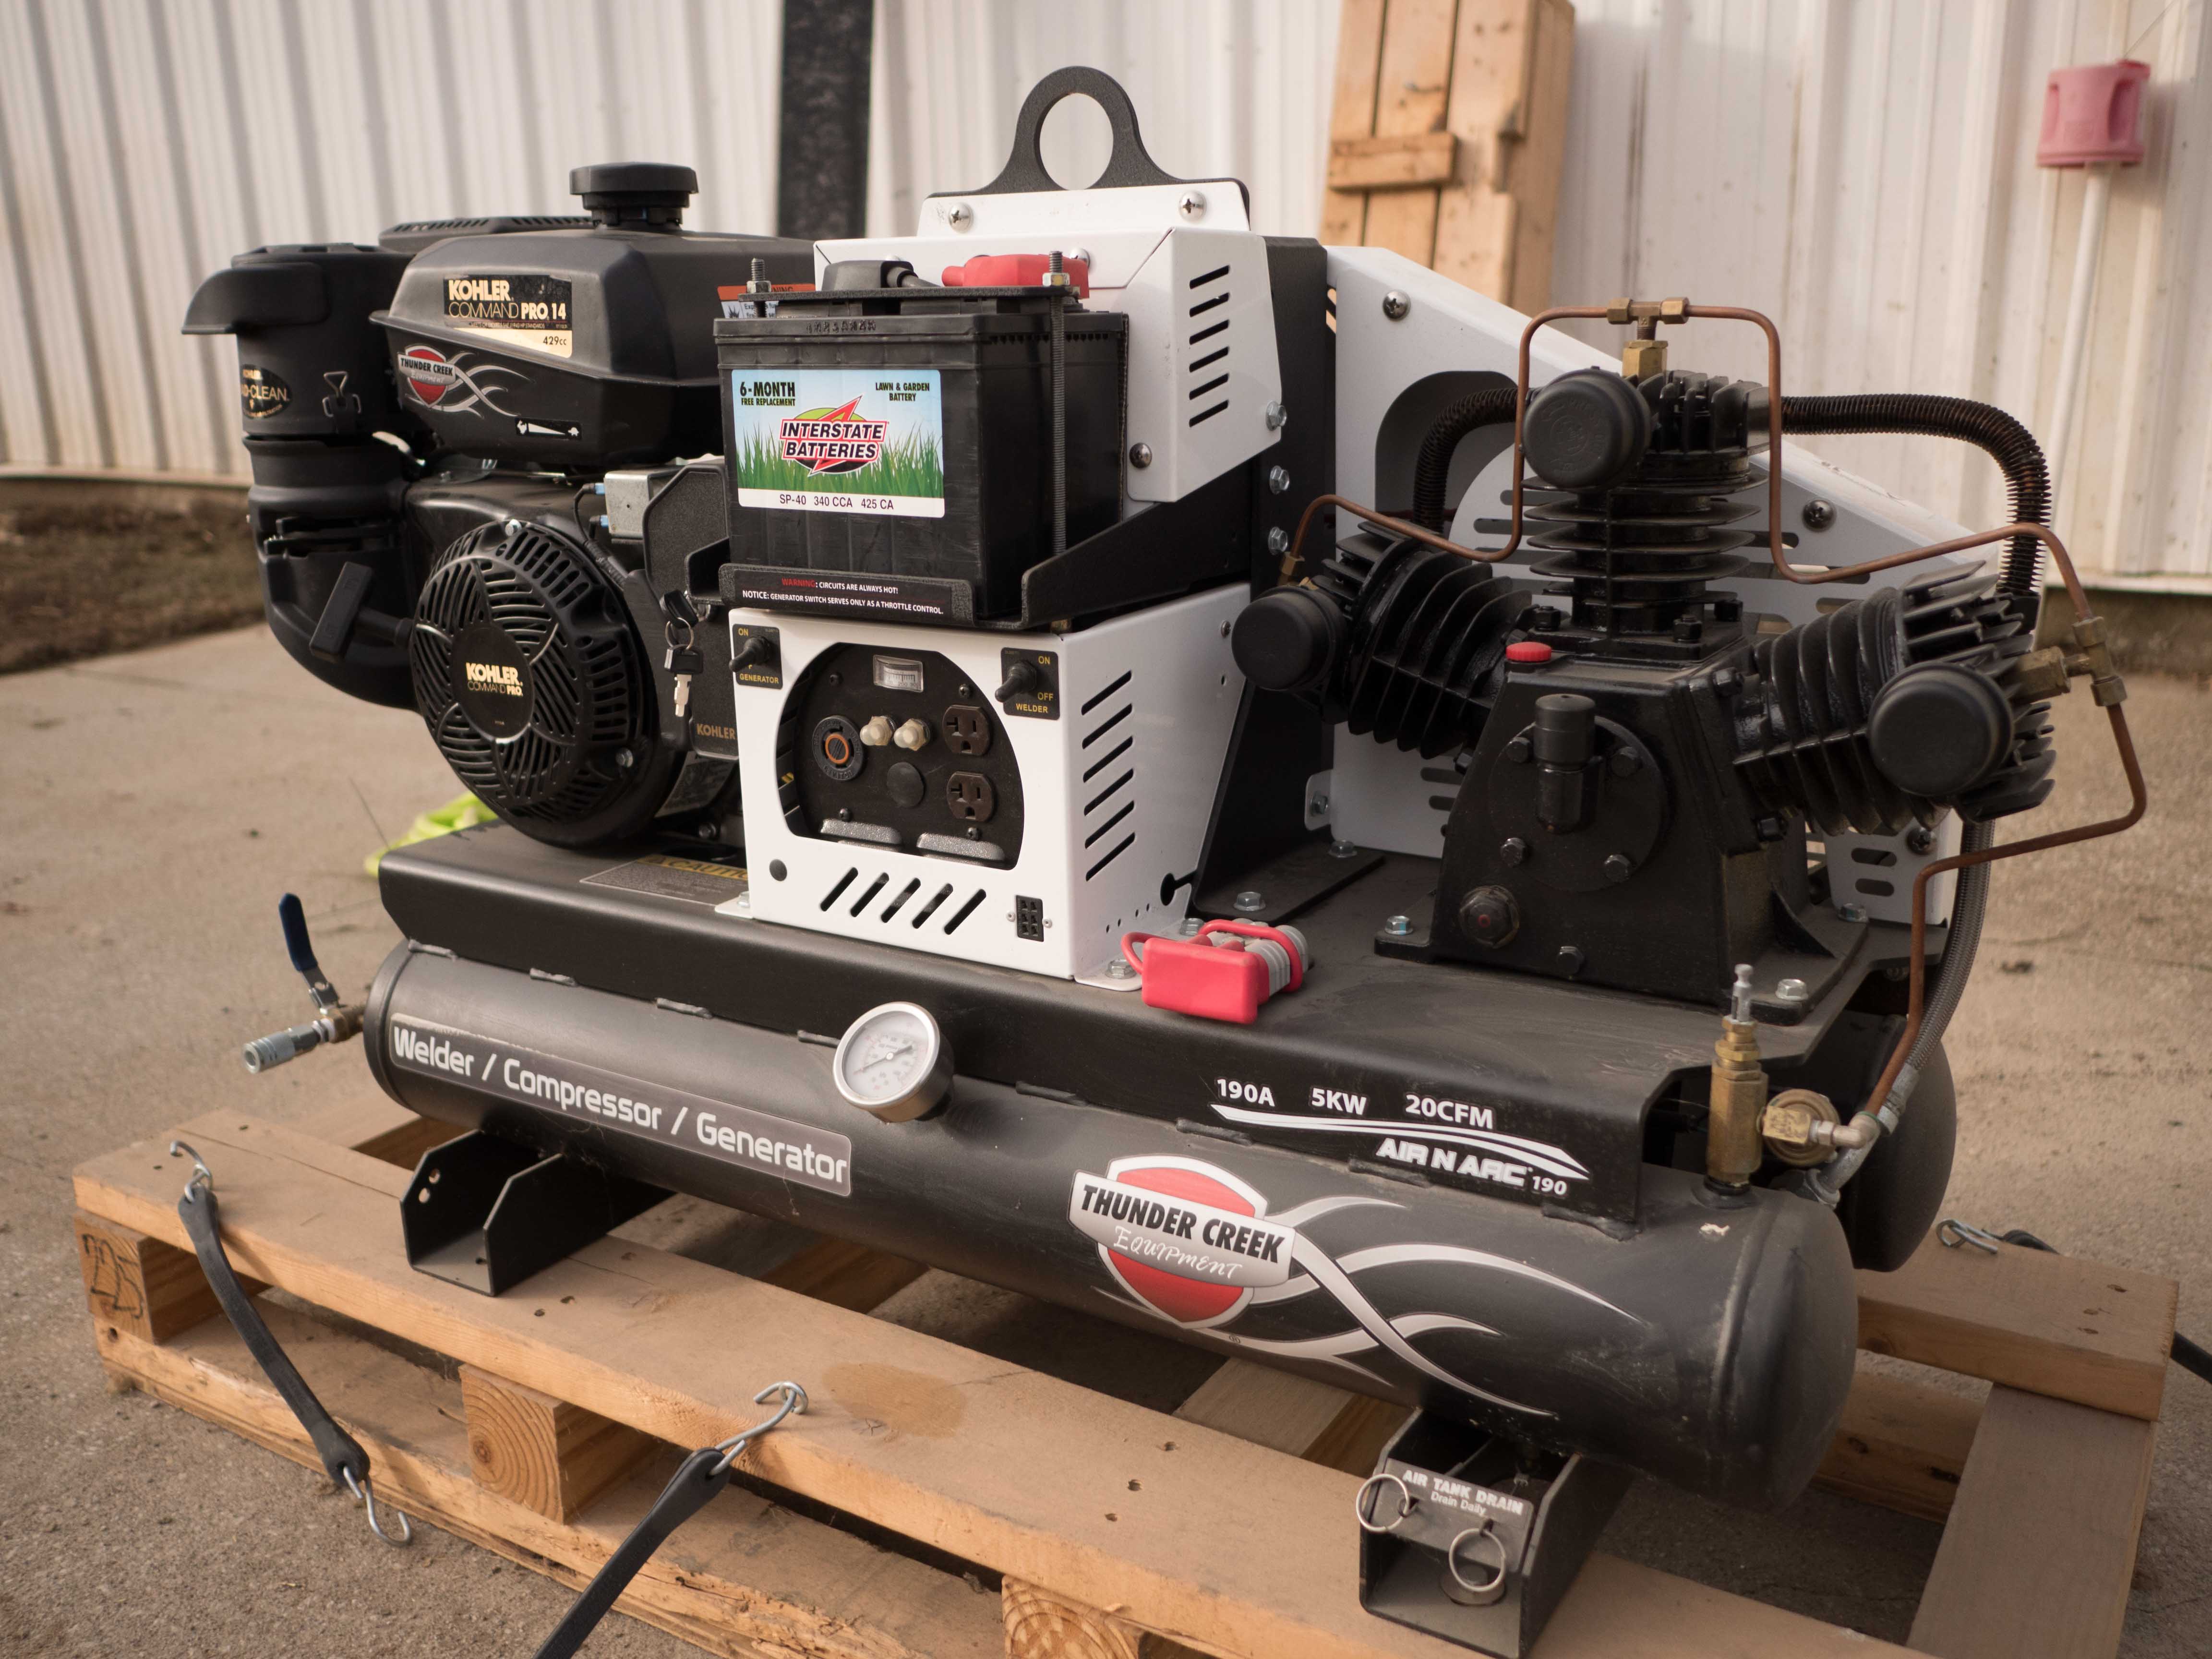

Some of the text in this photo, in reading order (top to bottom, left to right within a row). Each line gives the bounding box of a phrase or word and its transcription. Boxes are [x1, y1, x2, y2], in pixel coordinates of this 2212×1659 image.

[448, 280, 511, 301] KOHLER
[449, 301, 566, 320] COMMAND PRO 14
[543, 336, 567, 345] 429cc
[401, 358, 453, 376] THUNDER CREEK
[740, 382, 795, 397] 6-MONTH
[876, 383, 894, 391] LAWN
[903, 383, 930, 391] GARDEN
[756, 398, 795, 406] REPLACEMENT
[889, 393, 916, 402] BATTERY
[782, 422, 883, 439] INTERSTATE
[786, 442, 876, 458] BATTERIES
[780, 494, 894, 510] SP-40 340 CCA 425 CA
[781, 577, 818, 588] WARNING:
[819, 582, 845, 590] CIRCUITS
[859, 584, 882, 593] ALWAYS
[743, 590, 769, 600] NOTICE:
[770, 593, 804, 602] GENERATOR
[881, 601, 912, 611] THROTTLE
[913, 604, 944, 614] CONTROL.
[738, 628, 749, 636] ON
[1038, 656, 1050, 665] ON
[466, 662, 520, 686] KOHLER
[739, 673, 779, 684] GENERATOR
[468, 681, 506, 694] COMMAND
[1037, 692, 1054, 701] OFF
[1016, 703, 1048, 713] WELDER
[697, 723, 736, 740] KOHLER
[668, 860, 747, 878] CAUTI
[393, 1026, 847, 1184] Welder / Compressor / Generator
[1217, 1079, 1493, 1130] 190A 5KW 20CFM
[1376, 1138, 1567, 1195] AIR N ARC 190
[1081, 1184, 1286, 1264] THUNDER CREEK
[1402, 1469, 1523, 1515] AIR TANK DRAIN
[1431, 1491, 1487, 1517] Drain Daily
